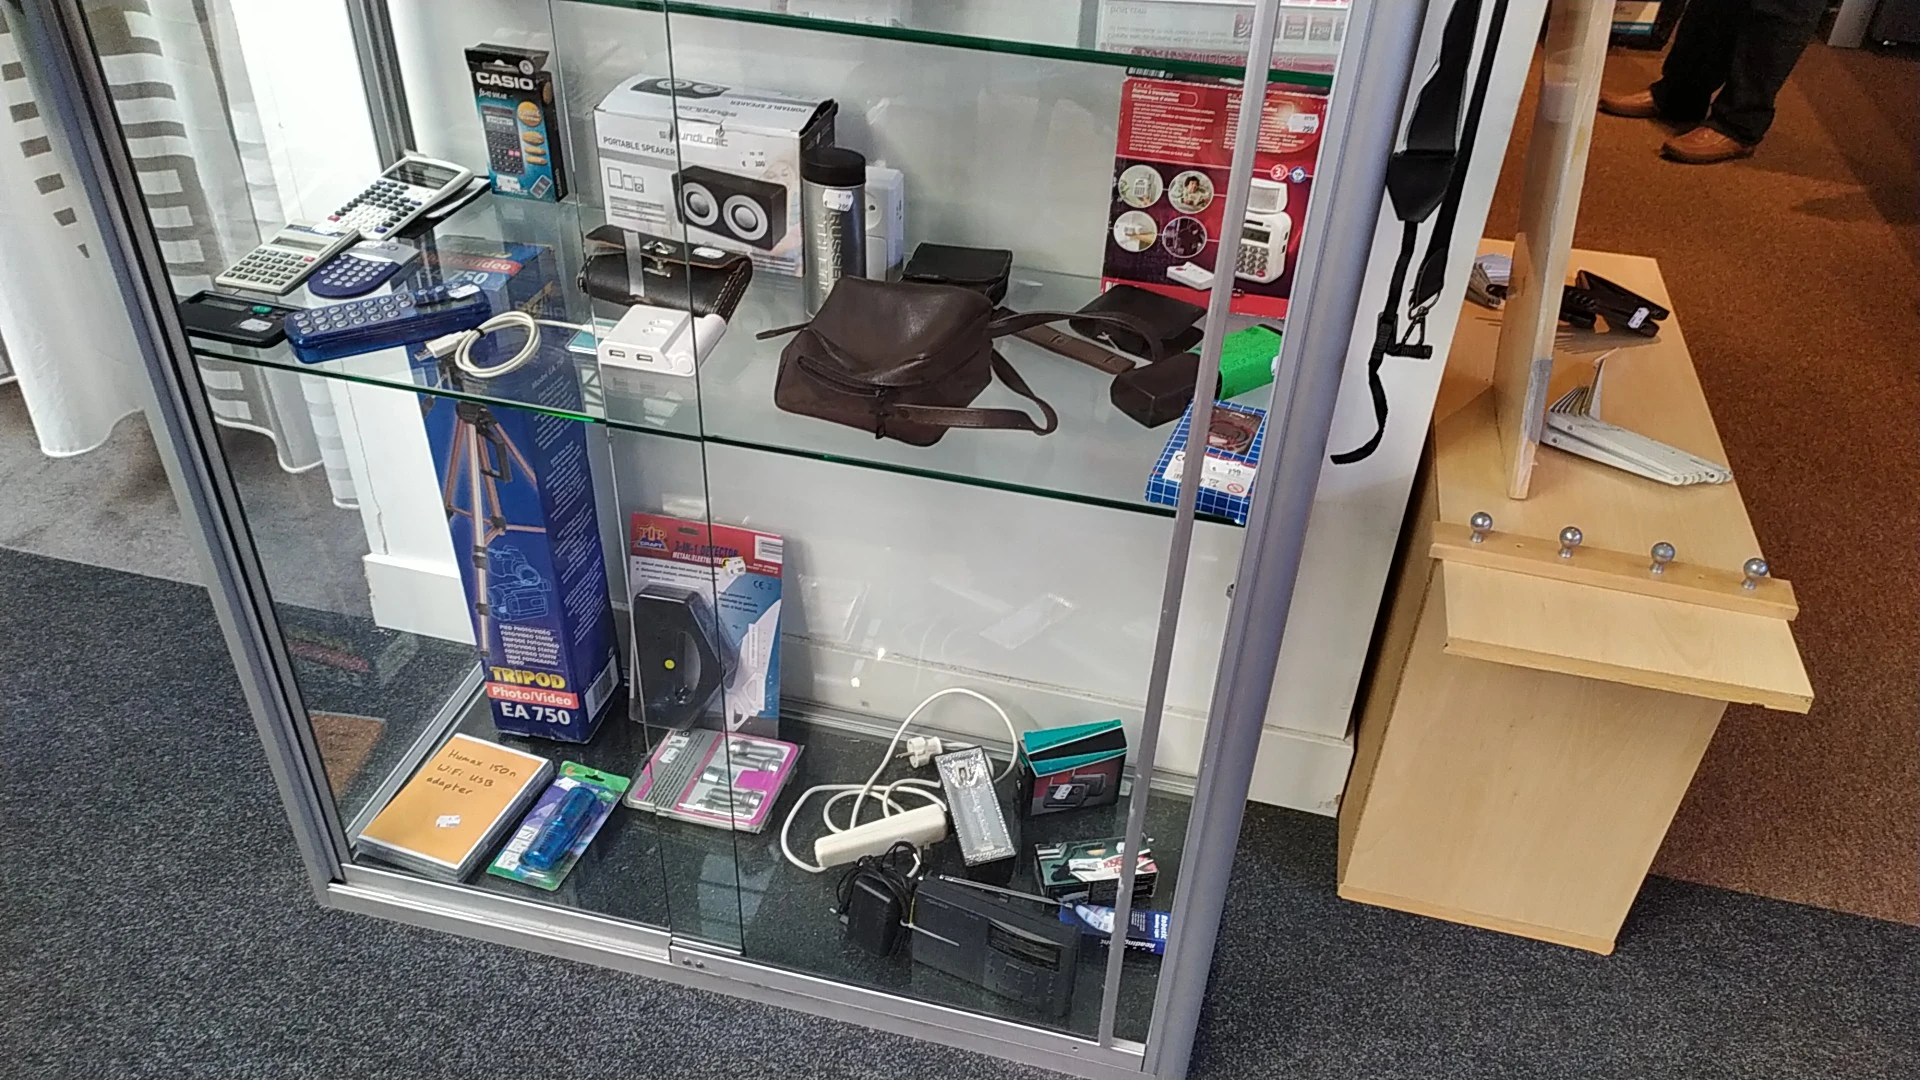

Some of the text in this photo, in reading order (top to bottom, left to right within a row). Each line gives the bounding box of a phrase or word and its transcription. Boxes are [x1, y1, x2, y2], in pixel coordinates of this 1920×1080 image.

[476, 71, 534, 90] CASIO
[730, 100, 807, 113] PORTABLE SPEAKER
[603, 136, 676, 157] PORTABLE SPEAKER
[489, 666, 566, 689] TRIPOD
[492, 686, 572, 706] Photo/Video
[500, 701, 571, 725] EA 750
[448, 749, 483, 766] Humax
[426, 777, 473, 794] adapter
[469, 774, 494, 787] USB
